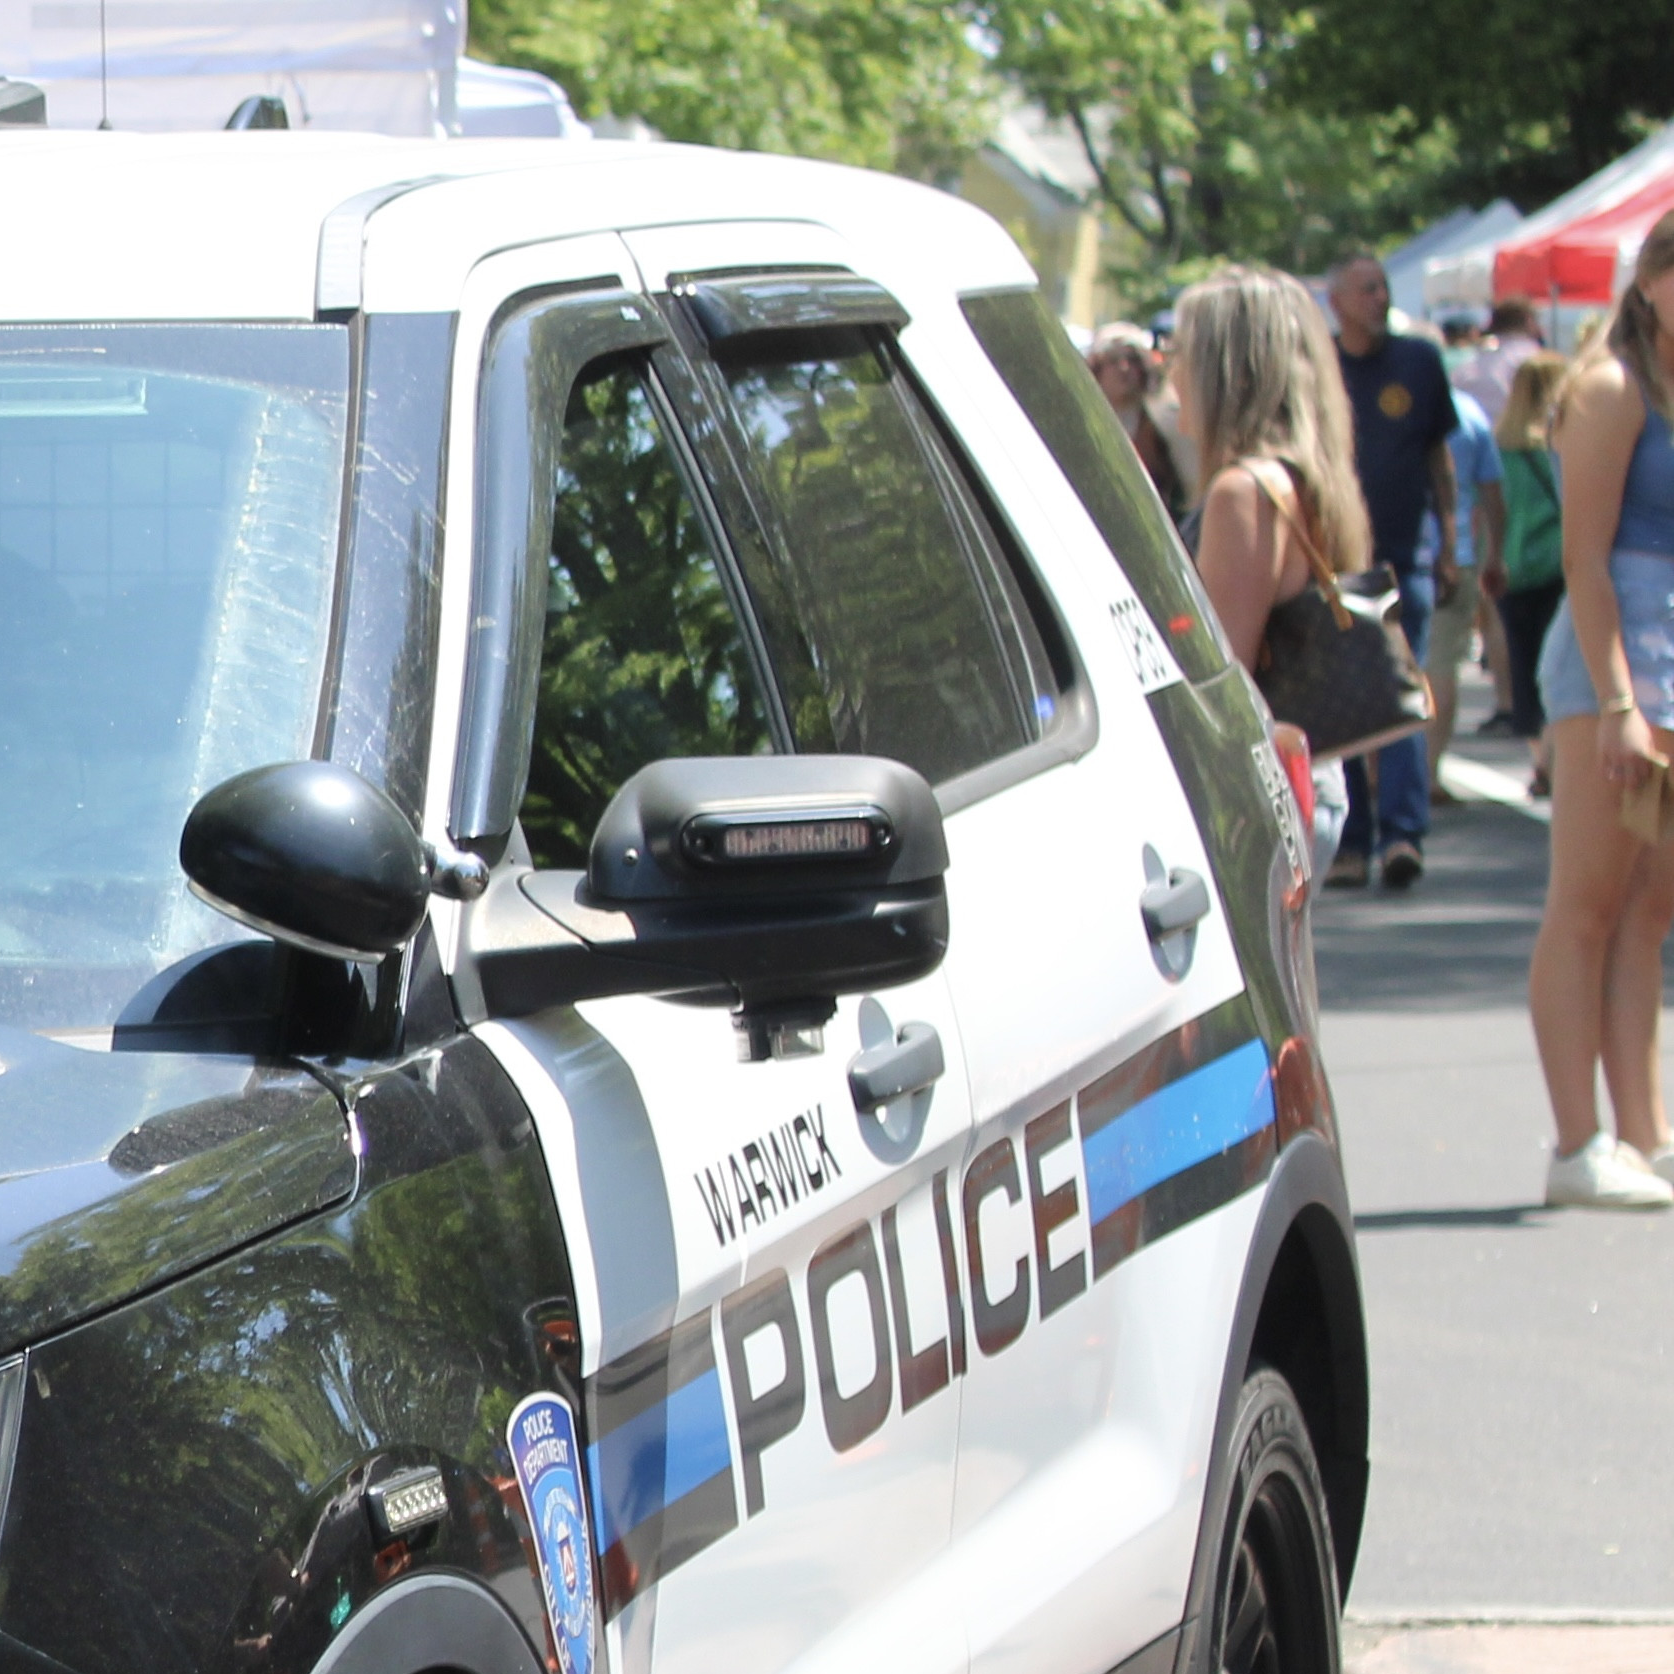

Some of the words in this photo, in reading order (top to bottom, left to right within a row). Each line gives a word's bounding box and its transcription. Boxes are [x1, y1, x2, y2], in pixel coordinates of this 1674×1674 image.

[694, 1103, 842, 1248] WARWICK
[720, 1095, 1088, 1521] POLICE
[522, 1408, 555, 1446] POLICE
[522, 1437, 569, 1486] DEPARTMENT
